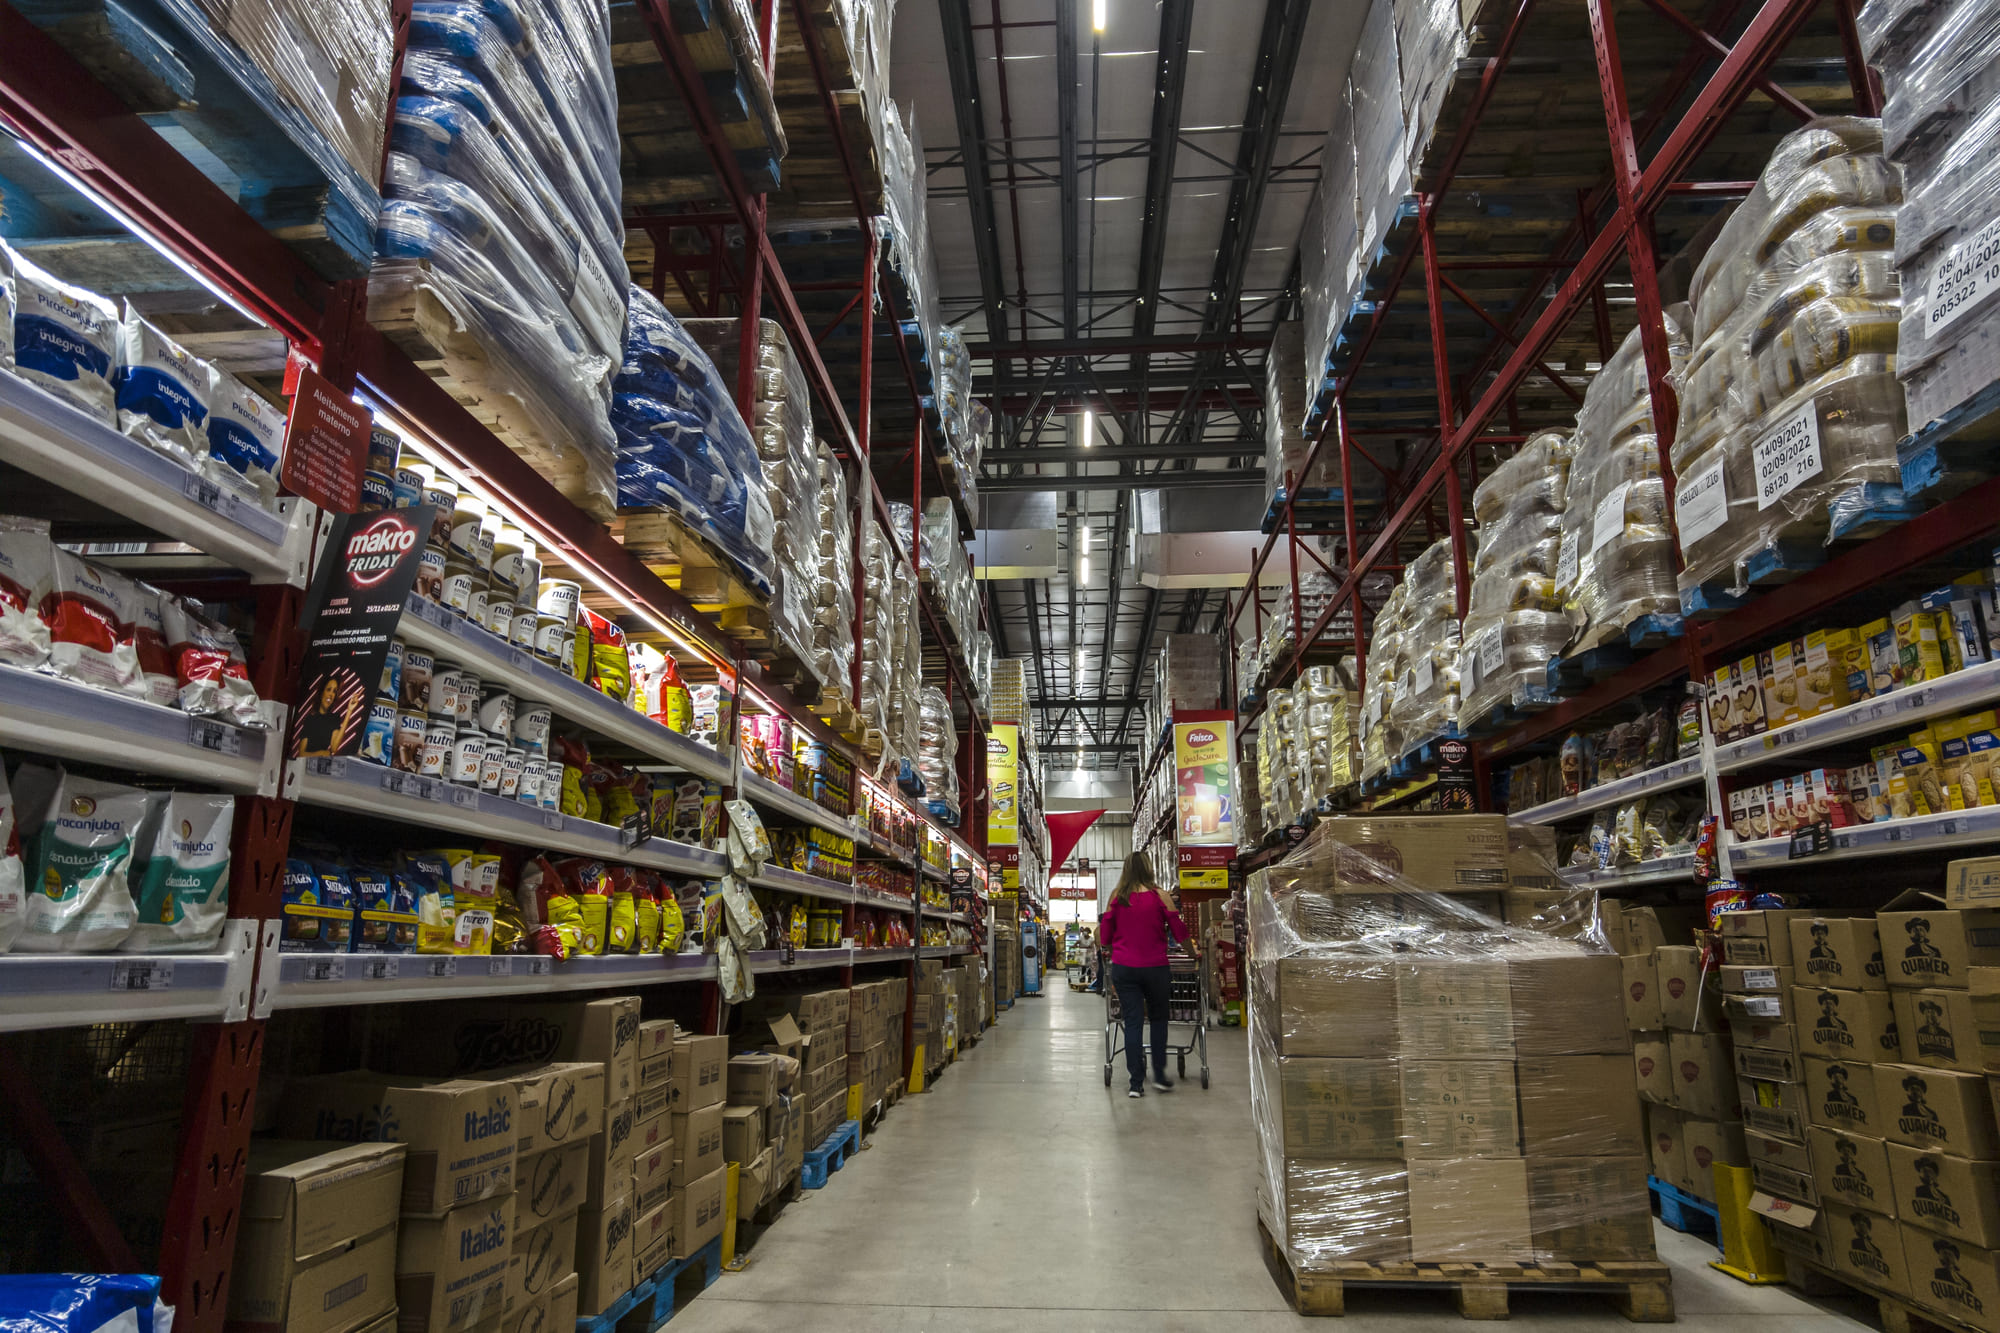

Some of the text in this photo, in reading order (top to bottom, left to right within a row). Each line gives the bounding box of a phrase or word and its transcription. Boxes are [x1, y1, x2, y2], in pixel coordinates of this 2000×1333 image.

[1939, 221, 2000, 279] 08/11/202
[1936, 239, 2000, 299] 25/04/202
[38, 294, 102, 332] Piracanjuba
[1932, 281, 1977, 323] 605322
[40, 328, 87, 357] integral
[158, 380, 191, 408] integral
[232, 401, 275, 437] Piracanjuba
[313, 388, 360, 429] Aleitamento
[318, 408, 351, 437] materno
[228, 430, 260, 456] integral
[372, 431, 398, 450] SUSTA
[1760, 417, 1809, 460] 14/09/2021
[1762, 436, 1811, 478] 02/09/2022
[1764, 455, 1814, 498] 68120 216
[348, 528, 415, 554] makro
[347, 552, 402, 573] FRIDAY
[1189, 732, 1214, 743] Frisco
[1440, 745, 1467, 753] makro
[57, 818, 120, 833] iracanjuba
[1181, 853, 1192, 862] 10
[1710, 900, 1747, 916] NESCAU
[1807, 957, 1842, 976] QUAKER
[1900, 957, 1951, 978] QUAKER
[1813, 1028, 1854, 1049] QUAKER
[315, 1109, 400, 1142] Italac
[464, 1107, 511, 1143] Italac
[1823, 1102, 1868, 1125] QUAKER
[1898, 1116, 1949, 1143] QUAKER
[1832, 1176, 1875, 1201] QUAKER
[1912, 1199, 1963, 1229] QUAKER
[460, 1222, 506, 1262] Italac
[1848, 1253, 1892, 1280] QUAKER
[1930, 1280, 1985, 1317] QUAKER
